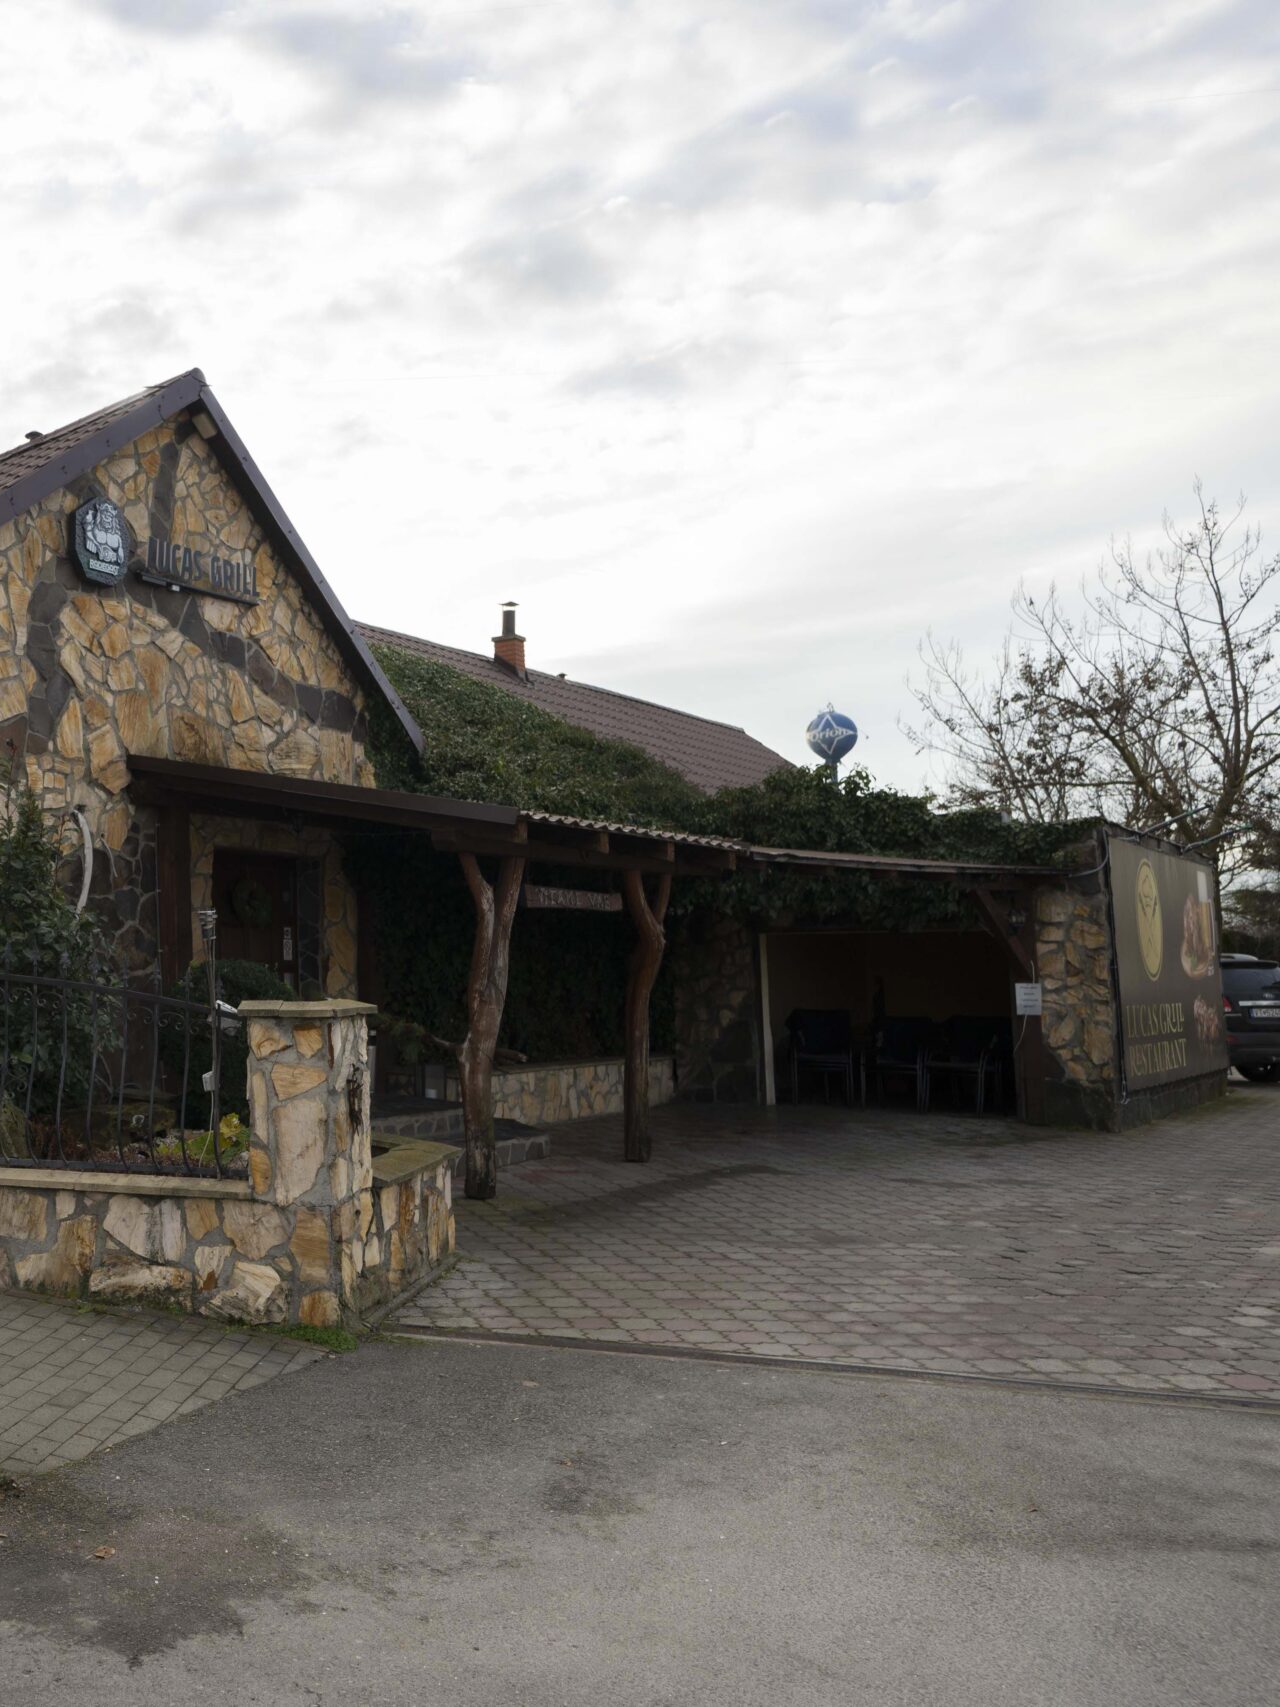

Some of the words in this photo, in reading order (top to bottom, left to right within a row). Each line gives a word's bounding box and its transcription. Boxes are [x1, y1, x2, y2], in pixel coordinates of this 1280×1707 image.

[144, 535, 203, 583] LUCAS
[209, 555, 261, 598] GRILL
[1125, 1003, 1159, 1039] LUCAS
[1159, 1002, 1185, 1034] GRILL
[1128, 1038, 1187, 1077] RESTAURANT
